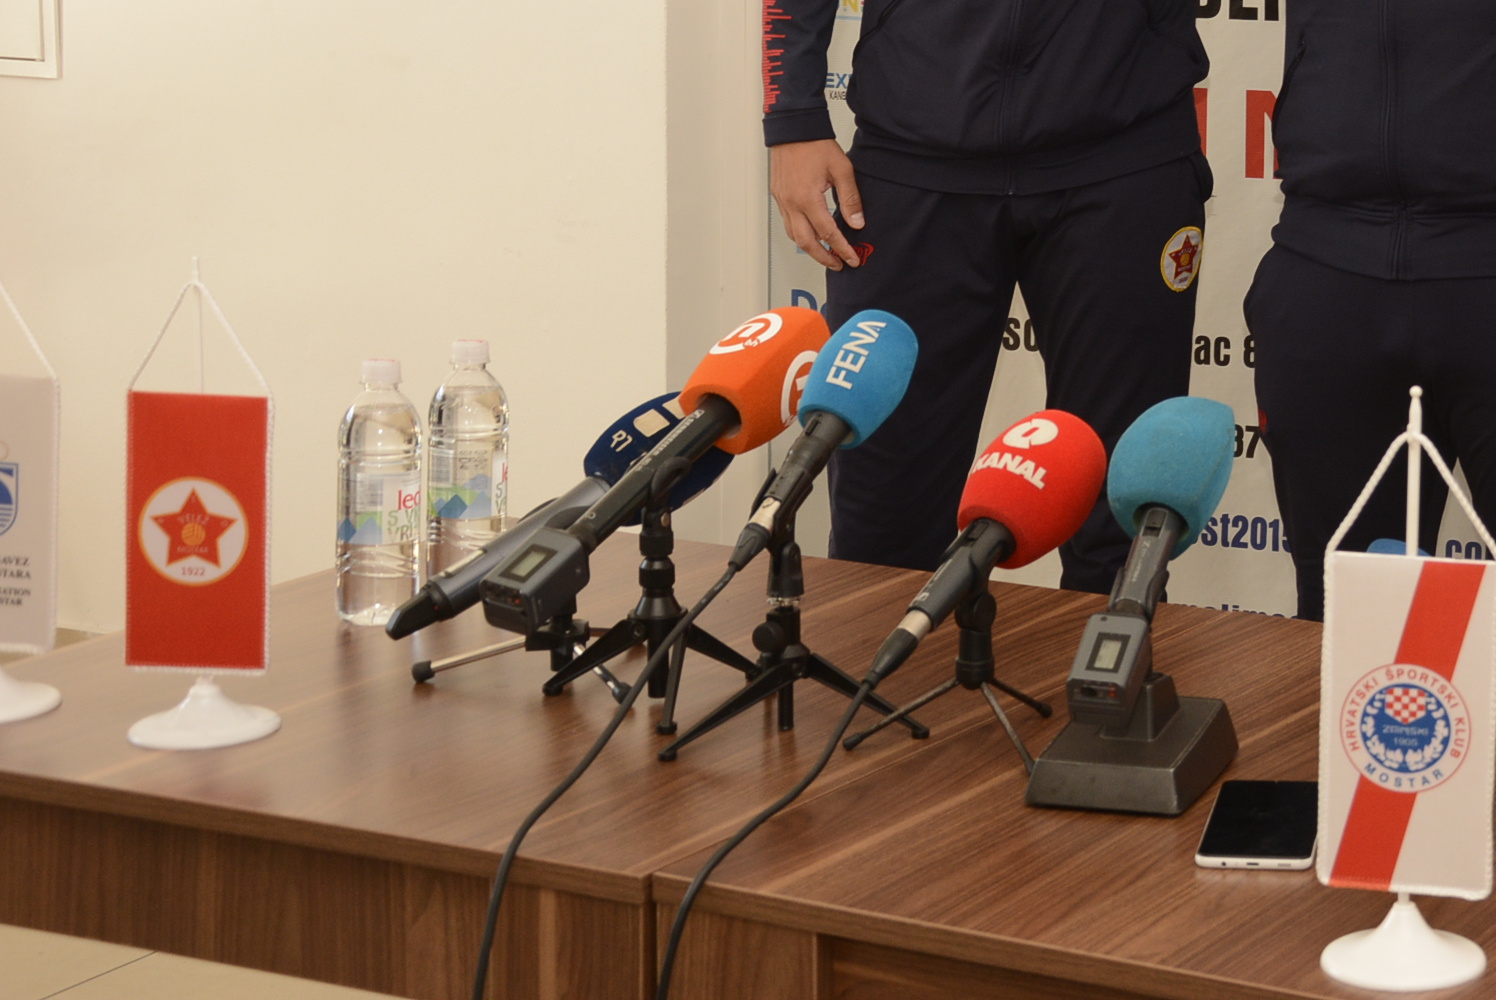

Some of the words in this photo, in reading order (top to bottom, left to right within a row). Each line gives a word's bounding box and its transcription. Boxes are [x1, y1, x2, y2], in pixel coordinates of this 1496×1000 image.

[825, 321, 887, 390] FENA
[970, 452, 1047, 490] KANAL
[181, 566, 206, 576] 1922
[1345, 677, 1378, 751] HRVATSKI
[1449, 716, 1465, 759] KLUB
[1364, 762, 1444, 788] MOSTAR
